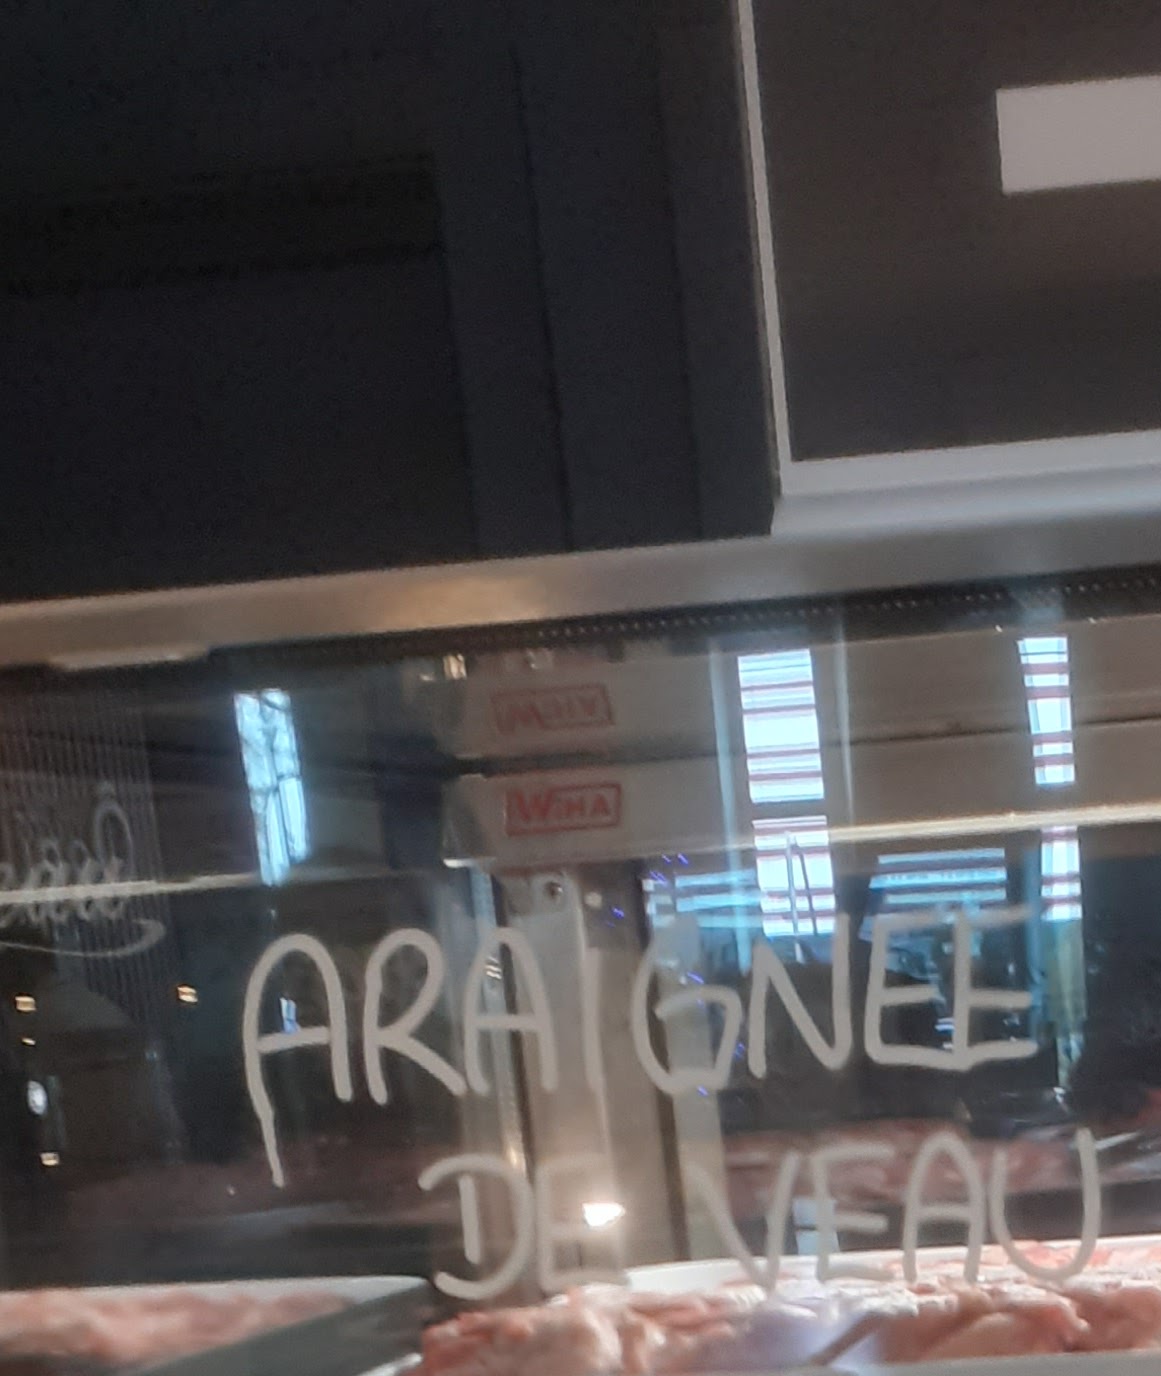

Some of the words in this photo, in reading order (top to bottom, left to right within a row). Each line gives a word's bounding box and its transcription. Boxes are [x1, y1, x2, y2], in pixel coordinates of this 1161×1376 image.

[243, 898, 1042, 1187] ARAIGNEE
[418, 1152, 630, 1300] DE
[686, 1128, 1100, 1294] VEAU
